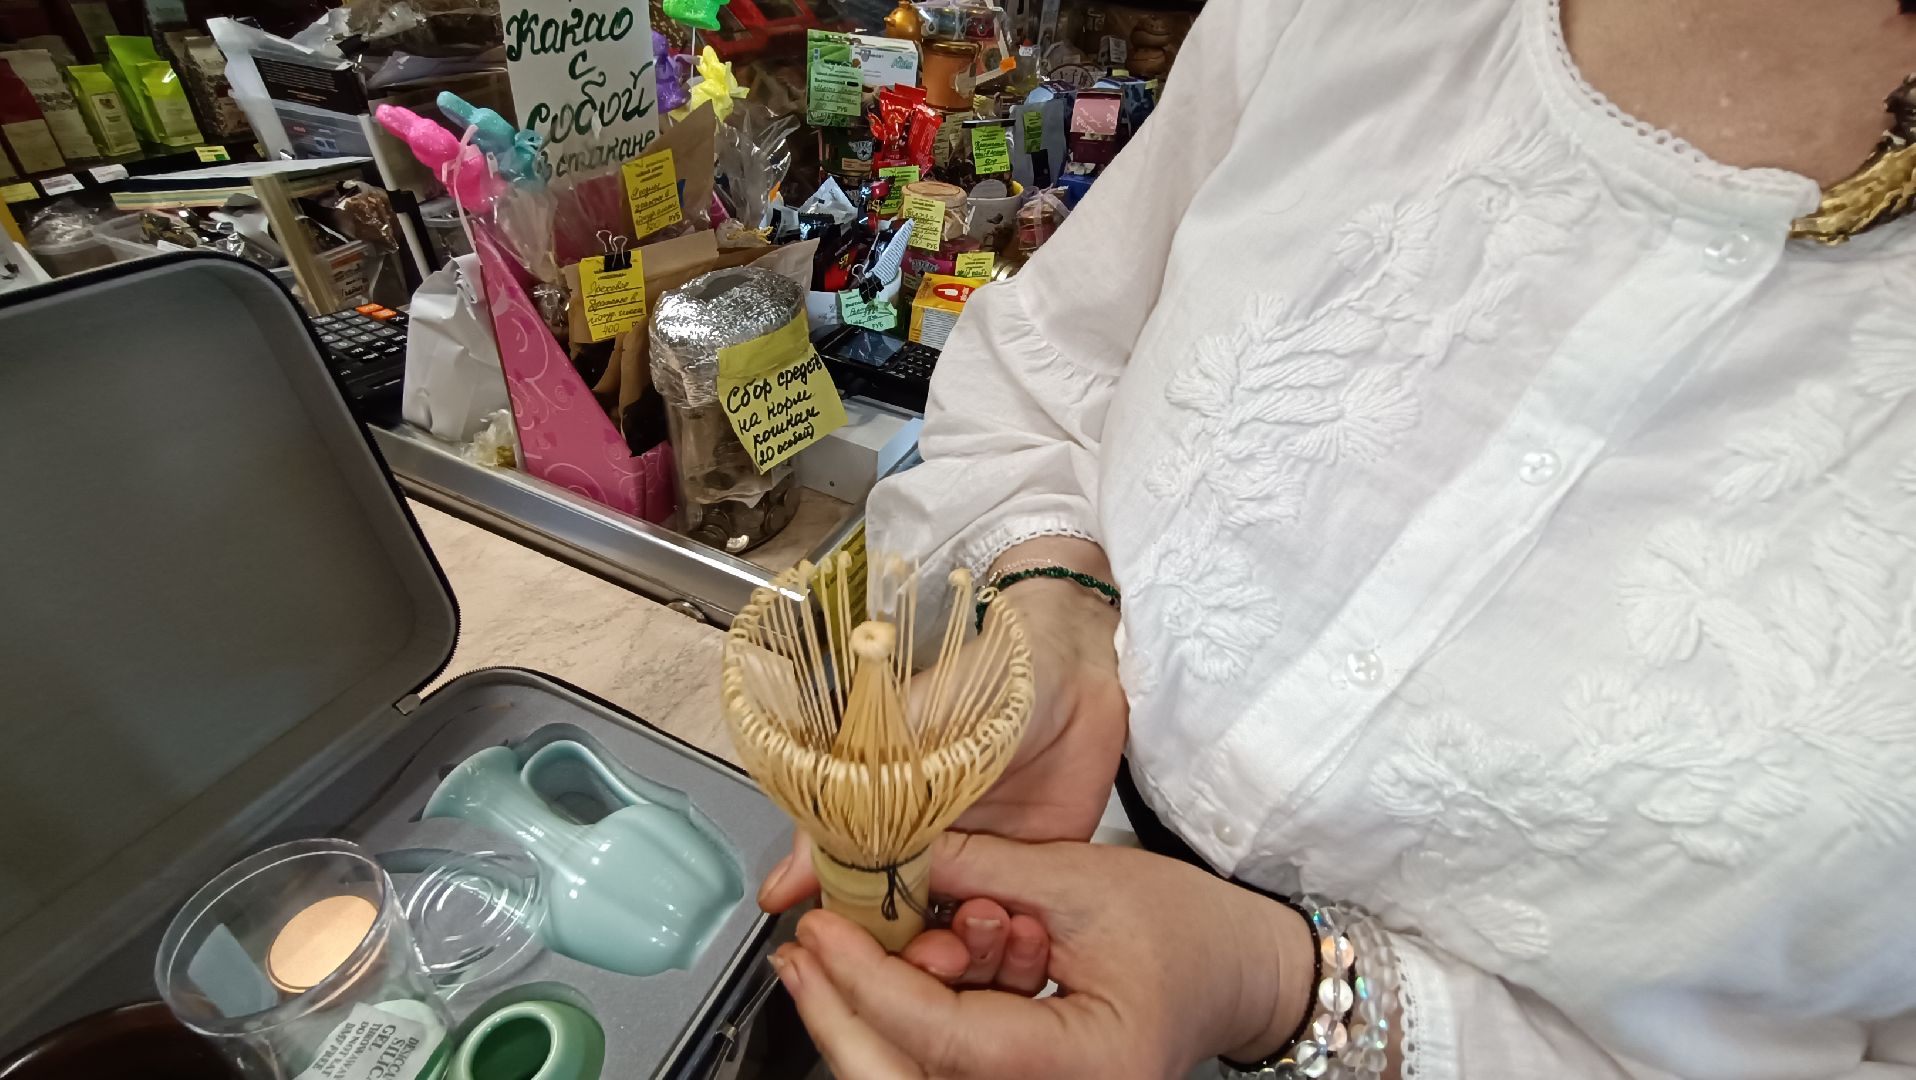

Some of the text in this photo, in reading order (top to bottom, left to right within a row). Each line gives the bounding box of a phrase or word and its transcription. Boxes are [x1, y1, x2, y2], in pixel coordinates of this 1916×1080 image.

[505, 7, 634, 62] Какао
[726, 352, 823, 414] Сбор средств
[738, 412, 762, 435] на
[753, 406, 820, 450] кошкам
[356, 1020, 370, 1036] DO
[371, 1024, 397, 1051] GEL
[311, 1044, 339, 1071] FREE
[340, 1036, 360, 1058] NOT
[366, 1037, 405, 1080] SILIC
